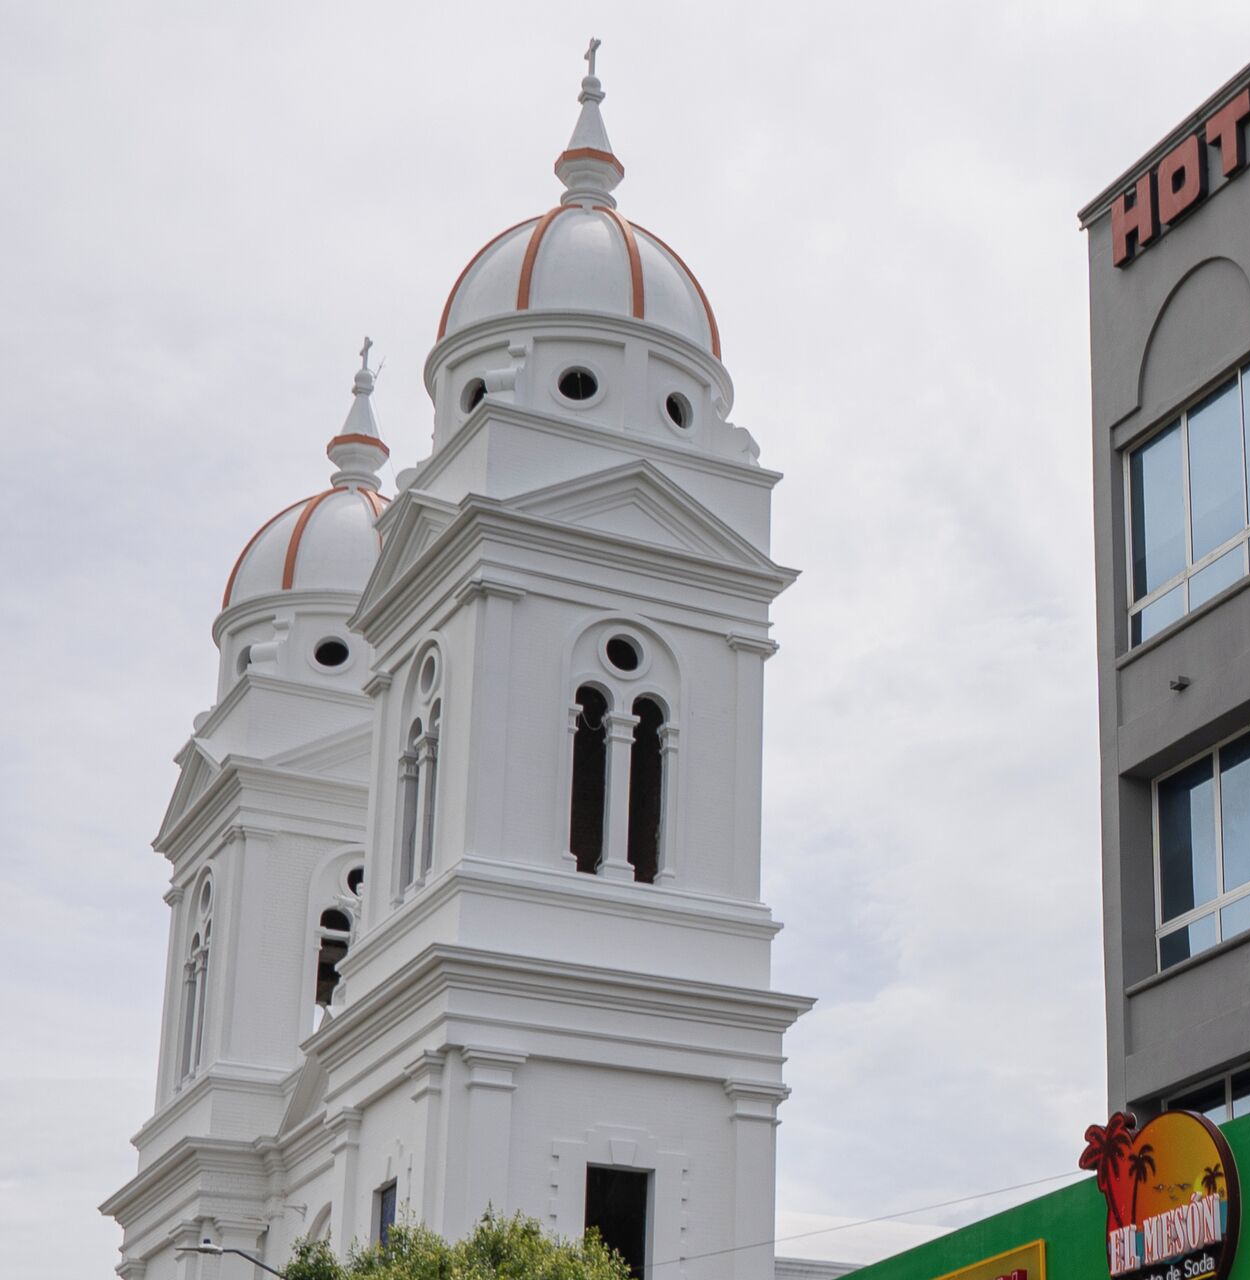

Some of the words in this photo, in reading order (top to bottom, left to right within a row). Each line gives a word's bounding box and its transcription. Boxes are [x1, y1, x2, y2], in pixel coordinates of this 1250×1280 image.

[1109, 1224, 1141, 1276] EL
[1143, 1192, 1222, 1266] MESÓN
[1184, 1252, 1216, 1279] Soda
